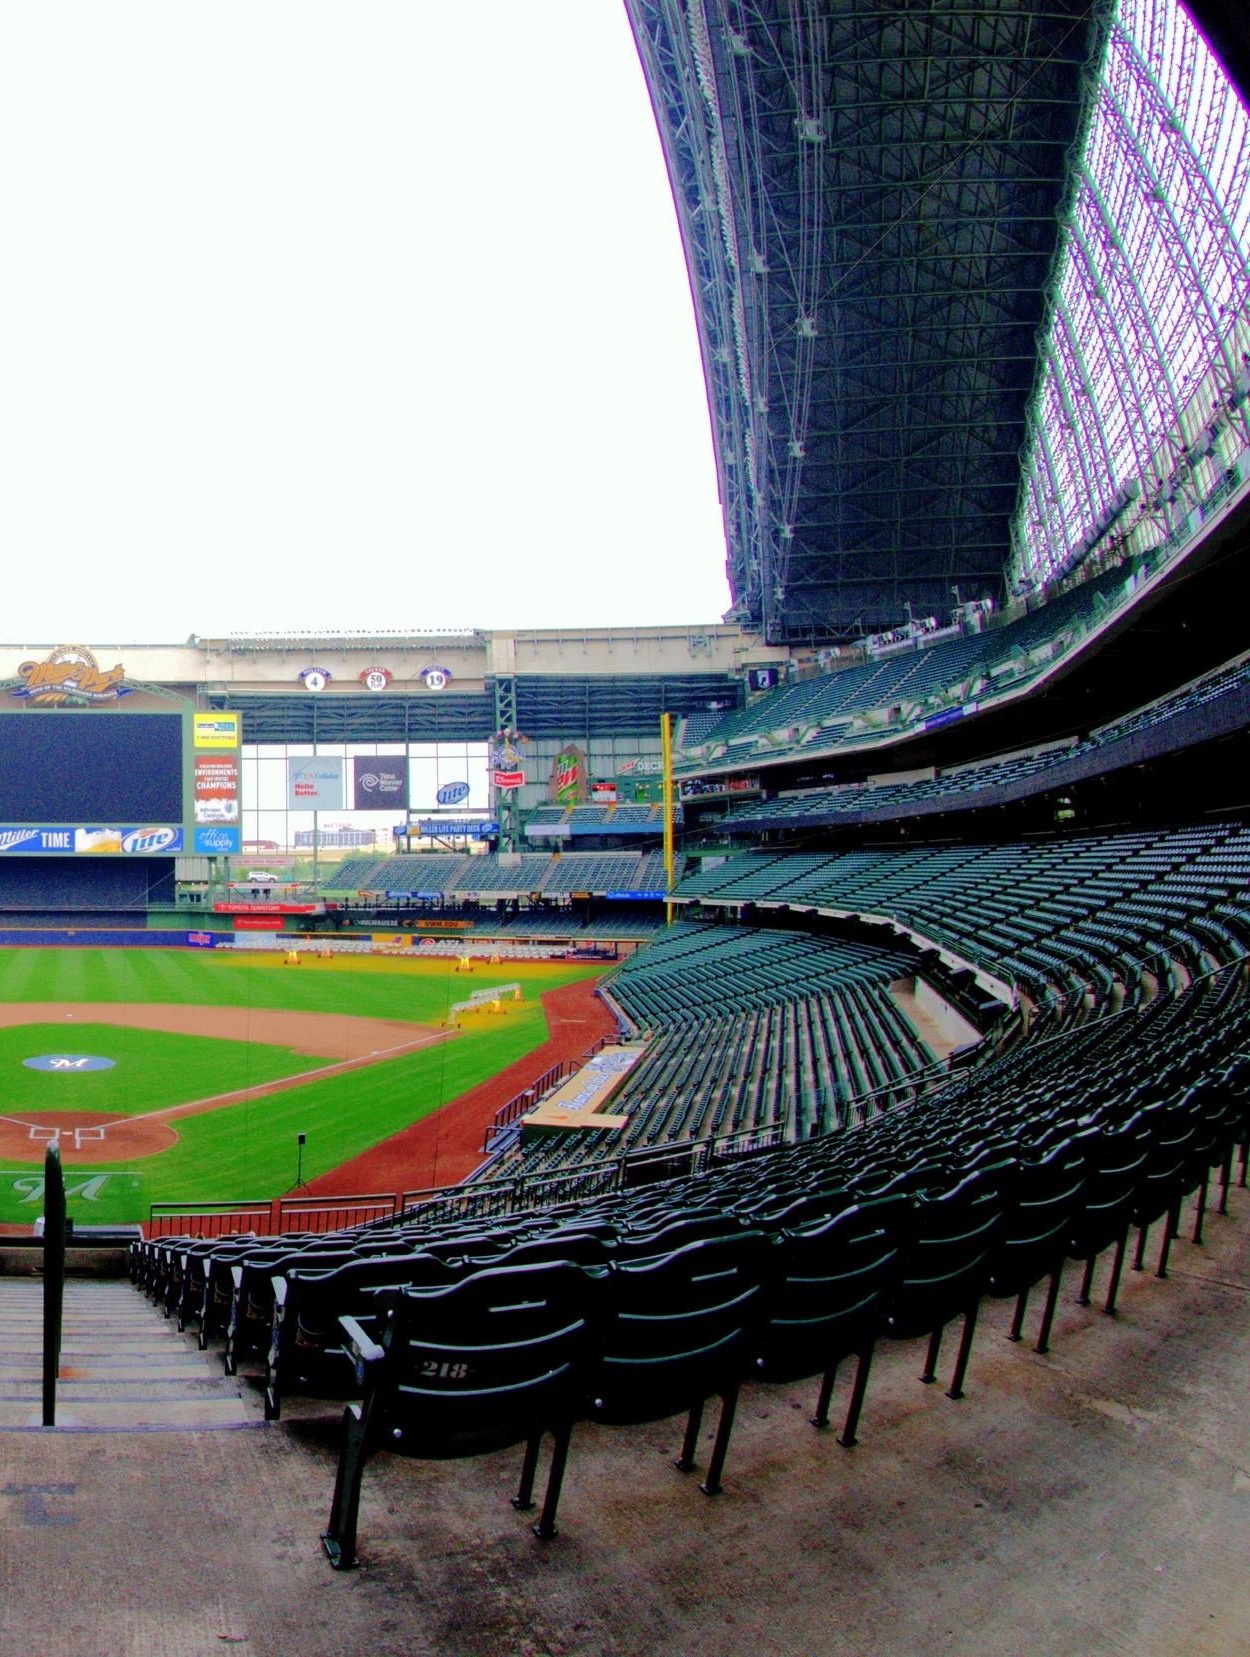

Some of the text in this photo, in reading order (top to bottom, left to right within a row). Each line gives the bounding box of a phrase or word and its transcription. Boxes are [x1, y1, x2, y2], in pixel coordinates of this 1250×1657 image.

[310, 676, 318, 687] 4
[370, 674, 383, 684] 50
[430, 675, 444, 686] 19
[196, 781, 237, 789] CHAMPIONS
[420, 824, 438, 833] MILLER
[439, 824, 449, 833] LITE
[450, 824, 467, 833] PARTY
[469, 824, 481, 833] DECK
[41, 832, 70, 848] TIME
[199, 829, 229, 844] office
[204, 839, 234, 848] supply
[188, 933, 211, 945] meijer
[49, 1058, 91, 1068] M
[419, 1360, 469, 1379] 218
